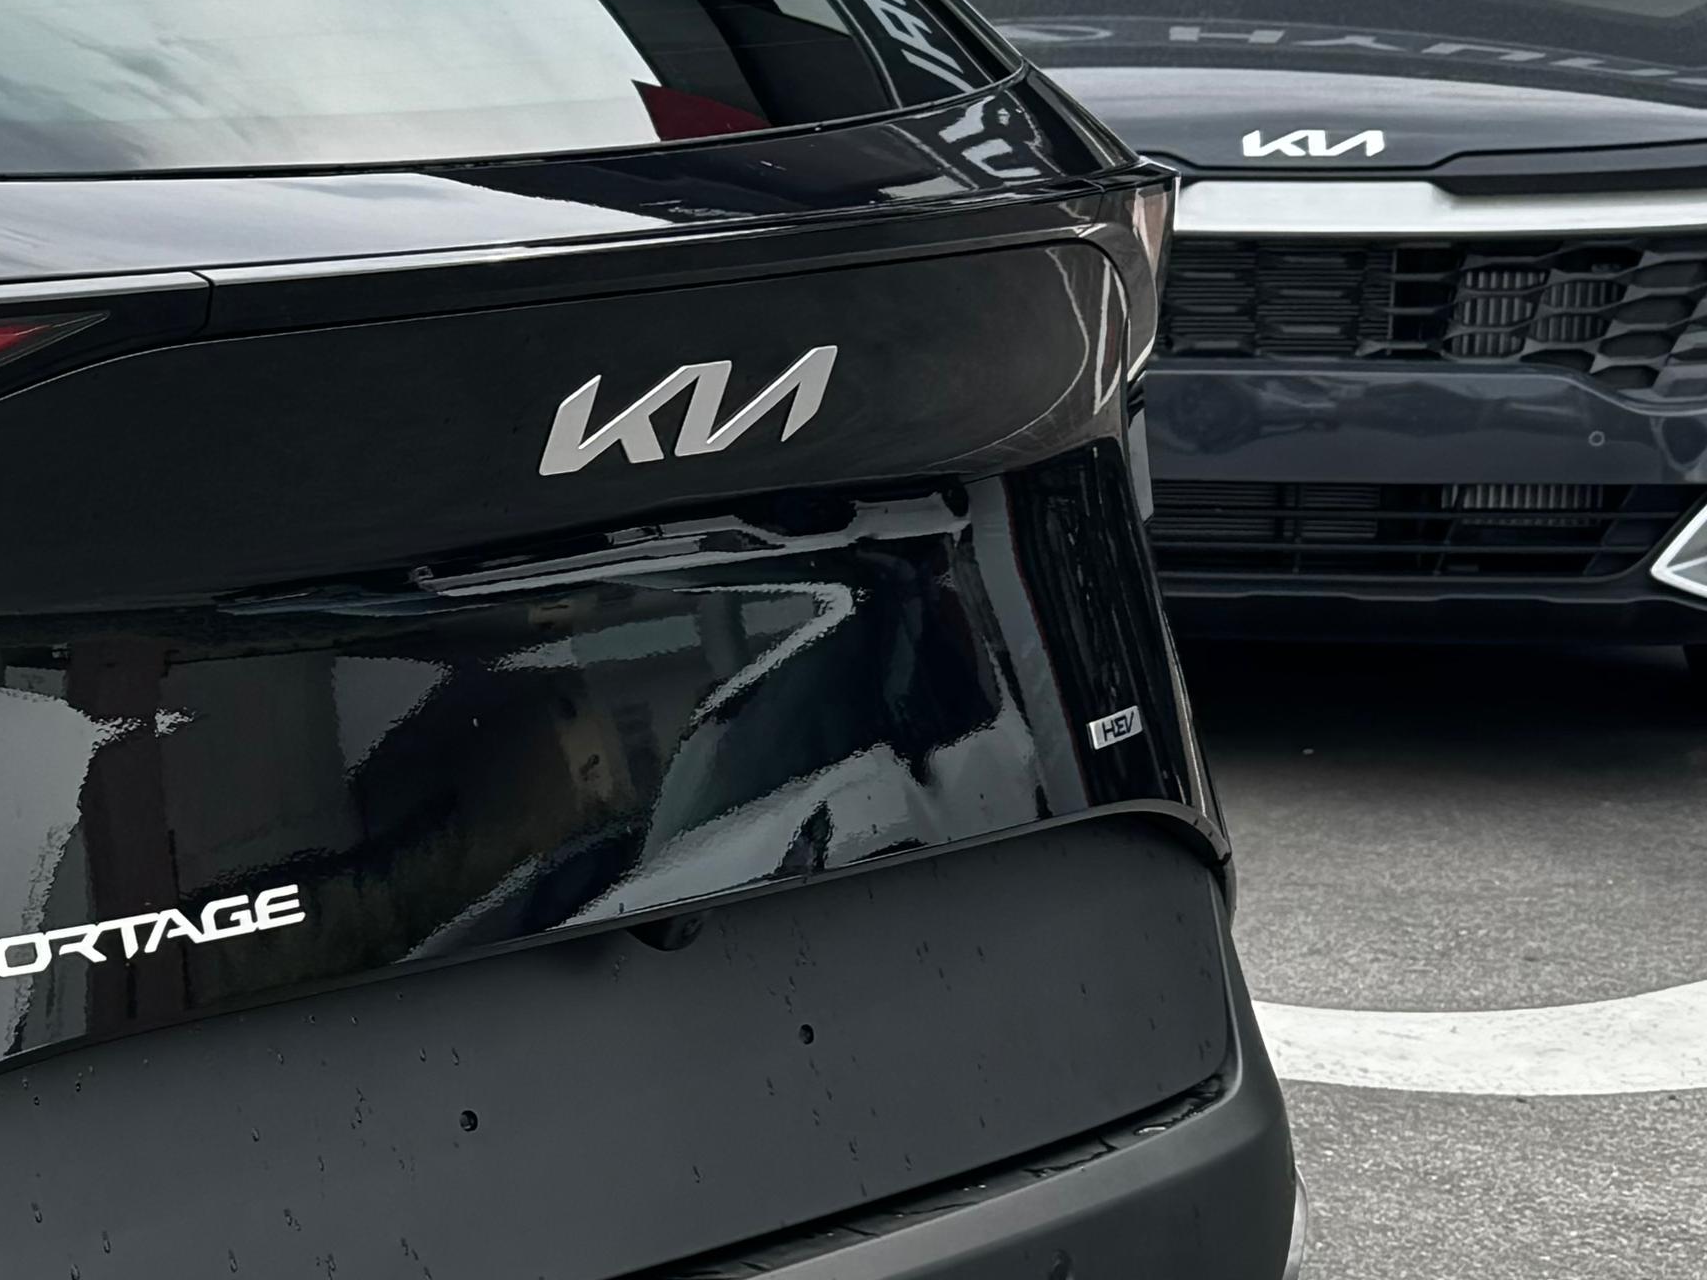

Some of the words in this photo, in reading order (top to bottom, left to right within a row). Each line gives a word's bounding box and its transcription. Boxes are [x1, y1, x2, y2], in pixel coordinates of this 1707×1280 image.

[1241, 128, 1386, 158] KIA
[539, 344, 839, 476] KIA
[1101, 711, 1135, 742] HEV
